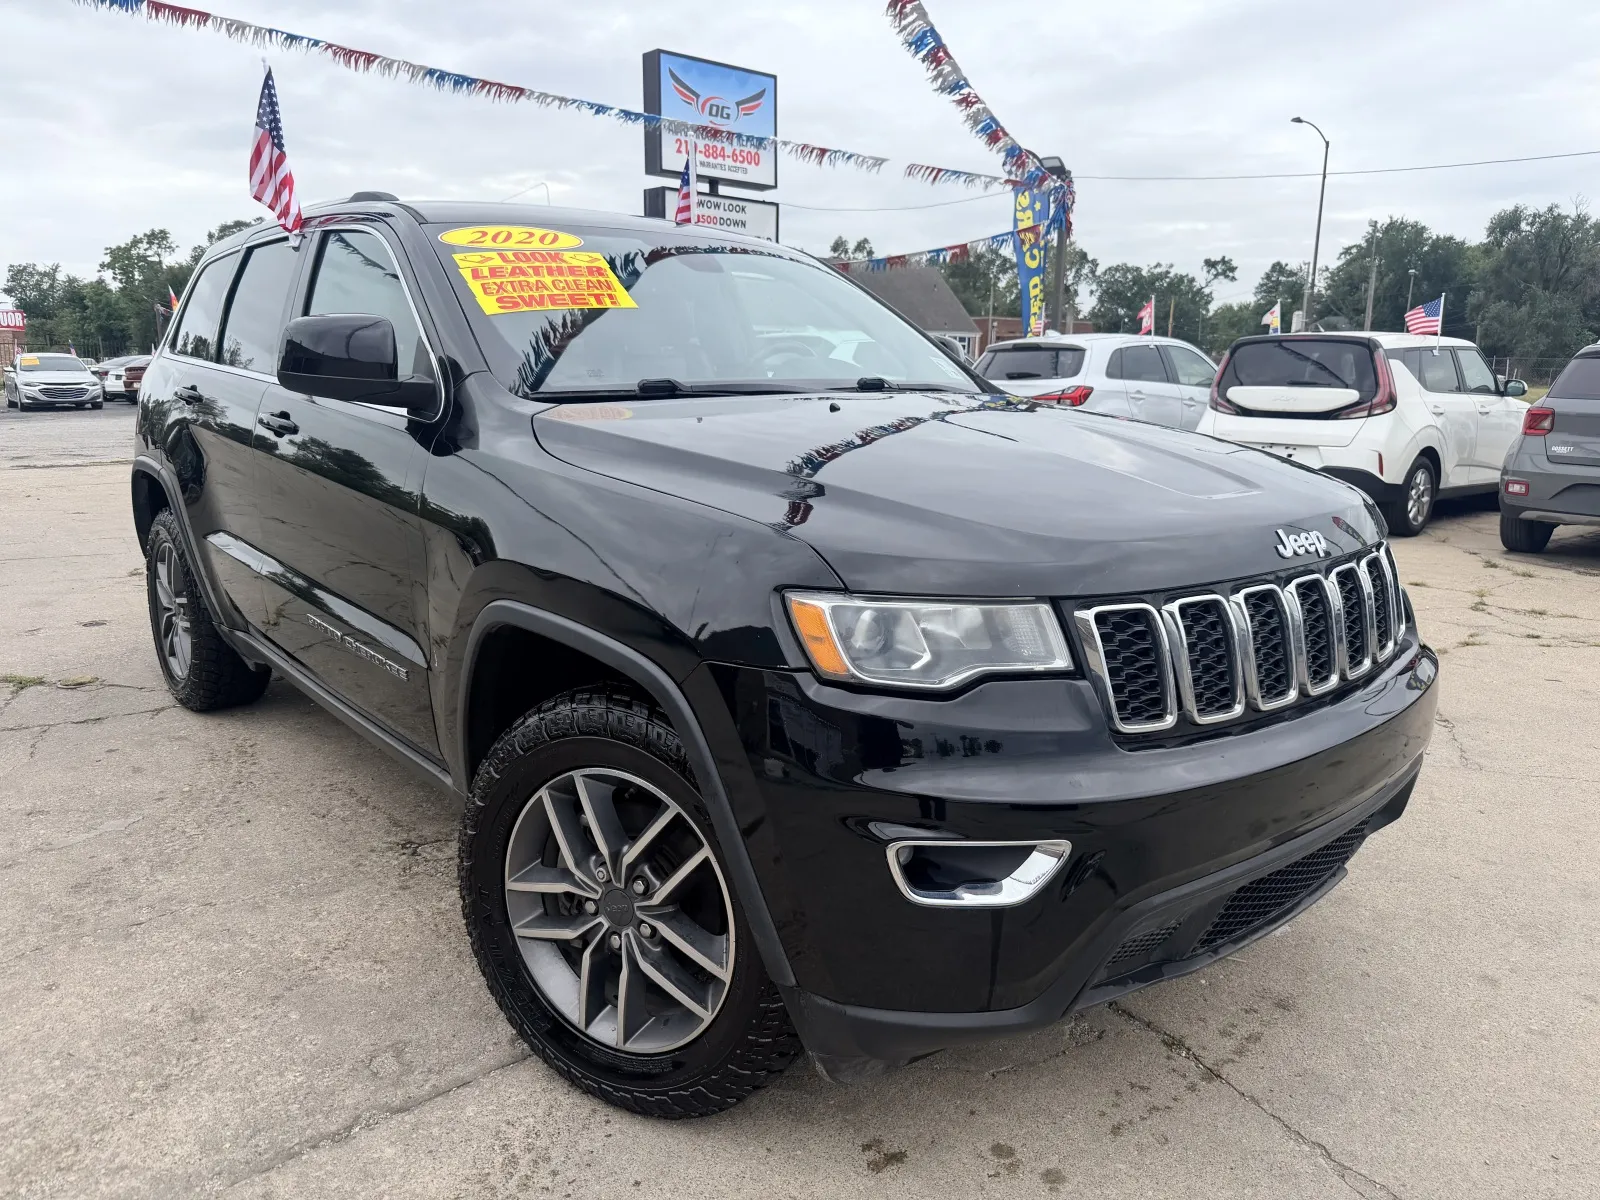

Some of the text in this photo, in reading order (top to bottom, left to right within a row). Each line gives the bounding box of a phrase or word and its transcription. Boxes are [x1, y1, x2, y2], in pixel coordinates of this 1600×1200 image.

[708, 102, 731, 121] OG
[675, 137, 761, 167] 21-884-6500
[697, 198, 748, 215] WOW LOOK
[719, 216, 747, 229] DOWN
[467, 230, 560, 246] 2020
[496, 251, 572, 265] LOOK
[471, 265, 611, 281] LEATHER
[480, 279, 617, 296] EXTRA CLEAN
[495, 293, 622, 310] SWEET!
[1274, 528, 1327, 559] Jeep
